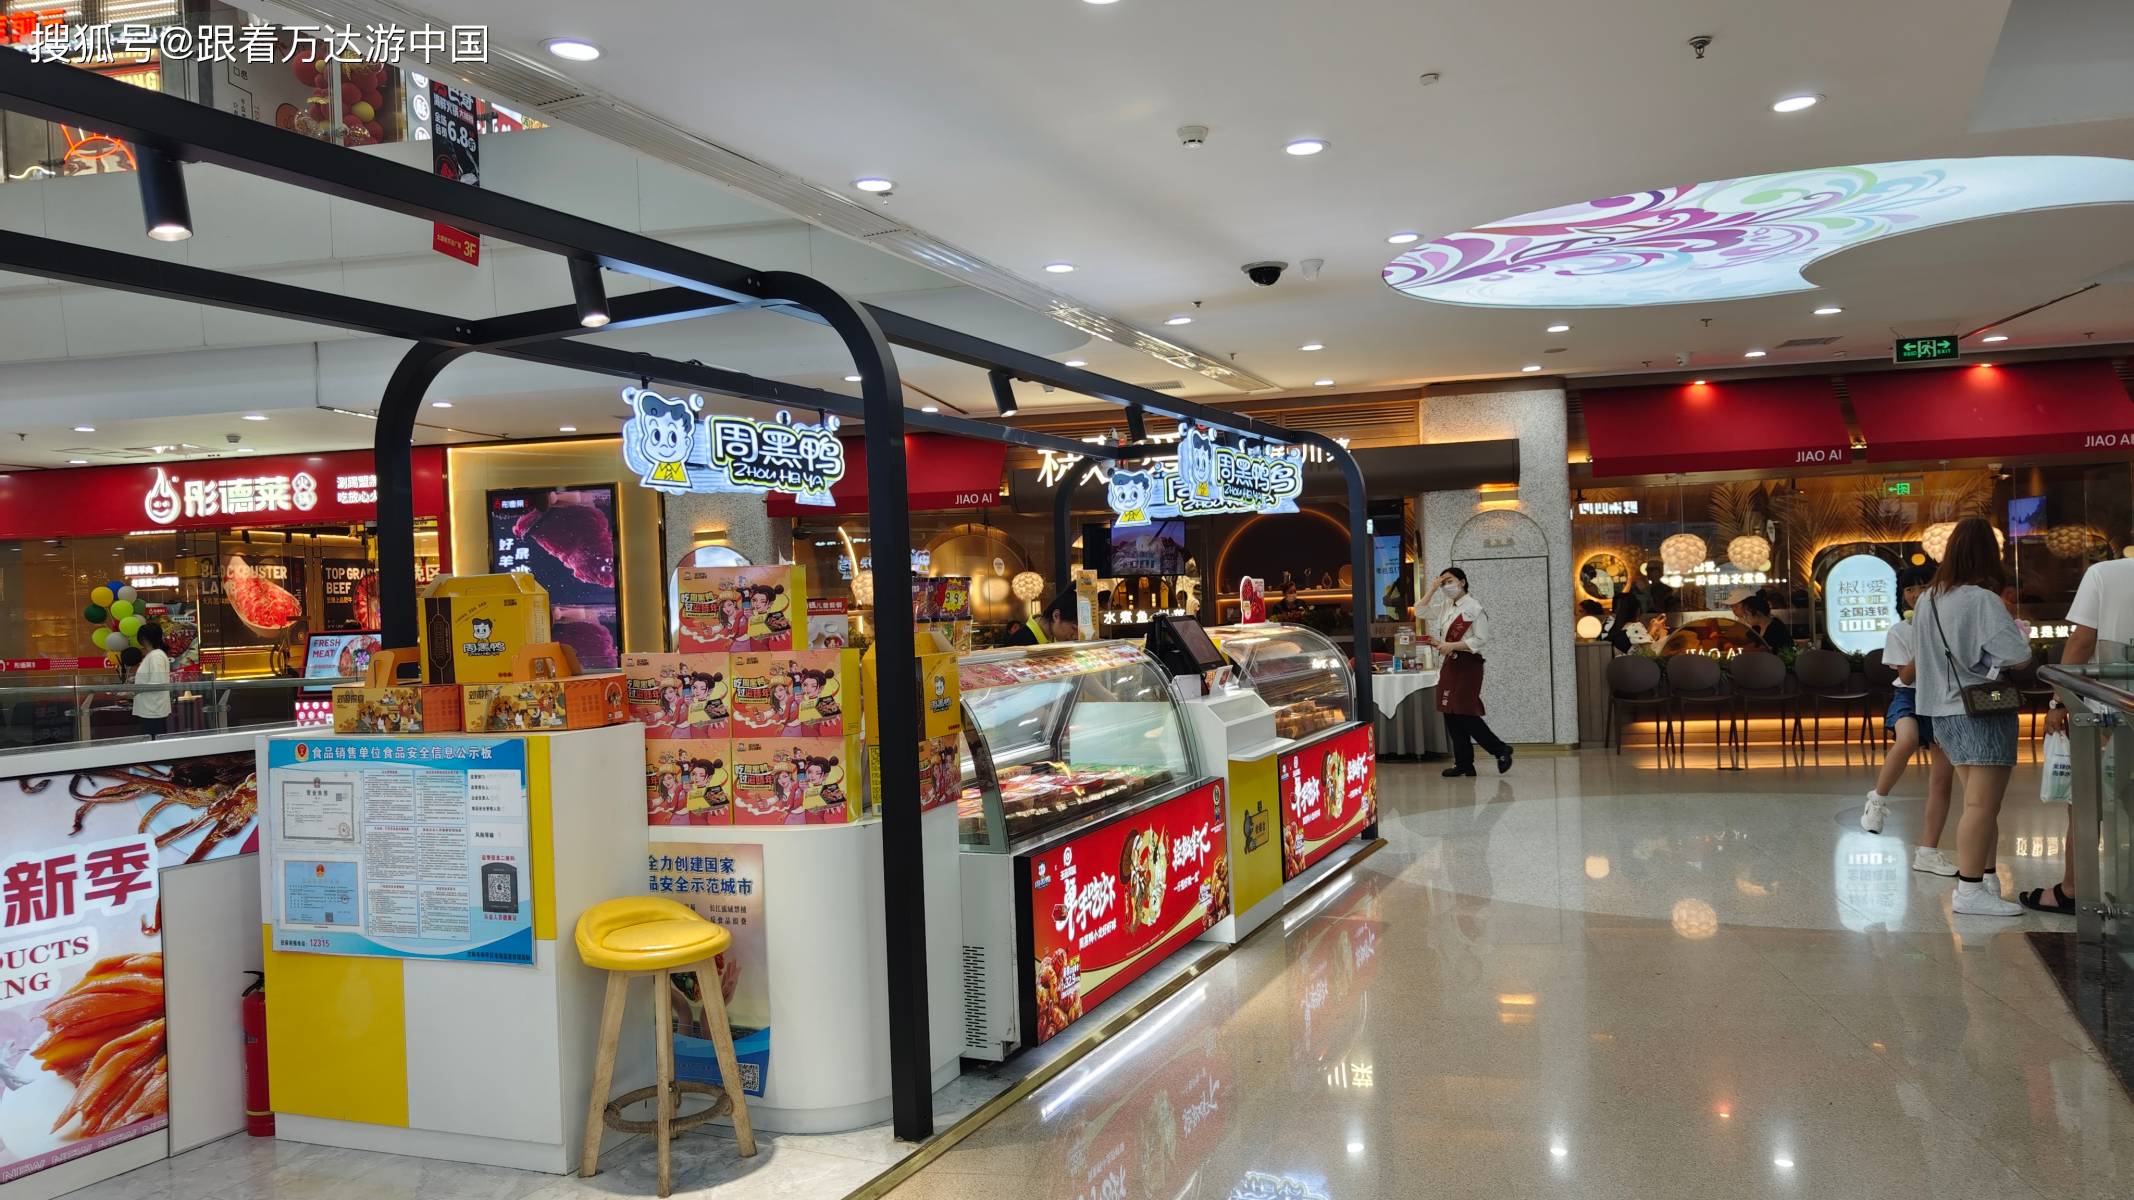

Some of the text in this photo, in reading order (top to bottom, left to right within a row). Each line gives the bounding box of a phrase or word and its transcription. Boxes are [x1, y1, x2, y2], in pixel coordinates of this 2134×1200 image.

[464, 241, 476, 257] 3F
[2085, 434, 2116, 448] JIAO
[715, 422, 840, 475] 周黑鸭
[1796, 450, 1842, 463] JIAO AI
[733, 463, 776, 480] ZHOU
[802, 471, 824, 487] YA
[184, 476, 291, 517] 彤德莱
[955, 493, 992, 504] JIAO AI
[326, 568, 345, 580] TOP
[326, 582, 351, 595] BEEF
[1104, 610, 1148, 624] 水煮鱼
[1840, 606, 1889, 617] 全国连锁
[1840, 619, 1889, 632] 100+
[314, 639, 341, 647] FRESH
[313, 649, 335, 658] MEAT
[312, 745, 492, 761] 食品销售单位食品安全信息公示板
[648, 855, 734, 873] 全力创建国家
[4, 842, 152, 928] 新季
[310, 939, 330, 947] 12315
